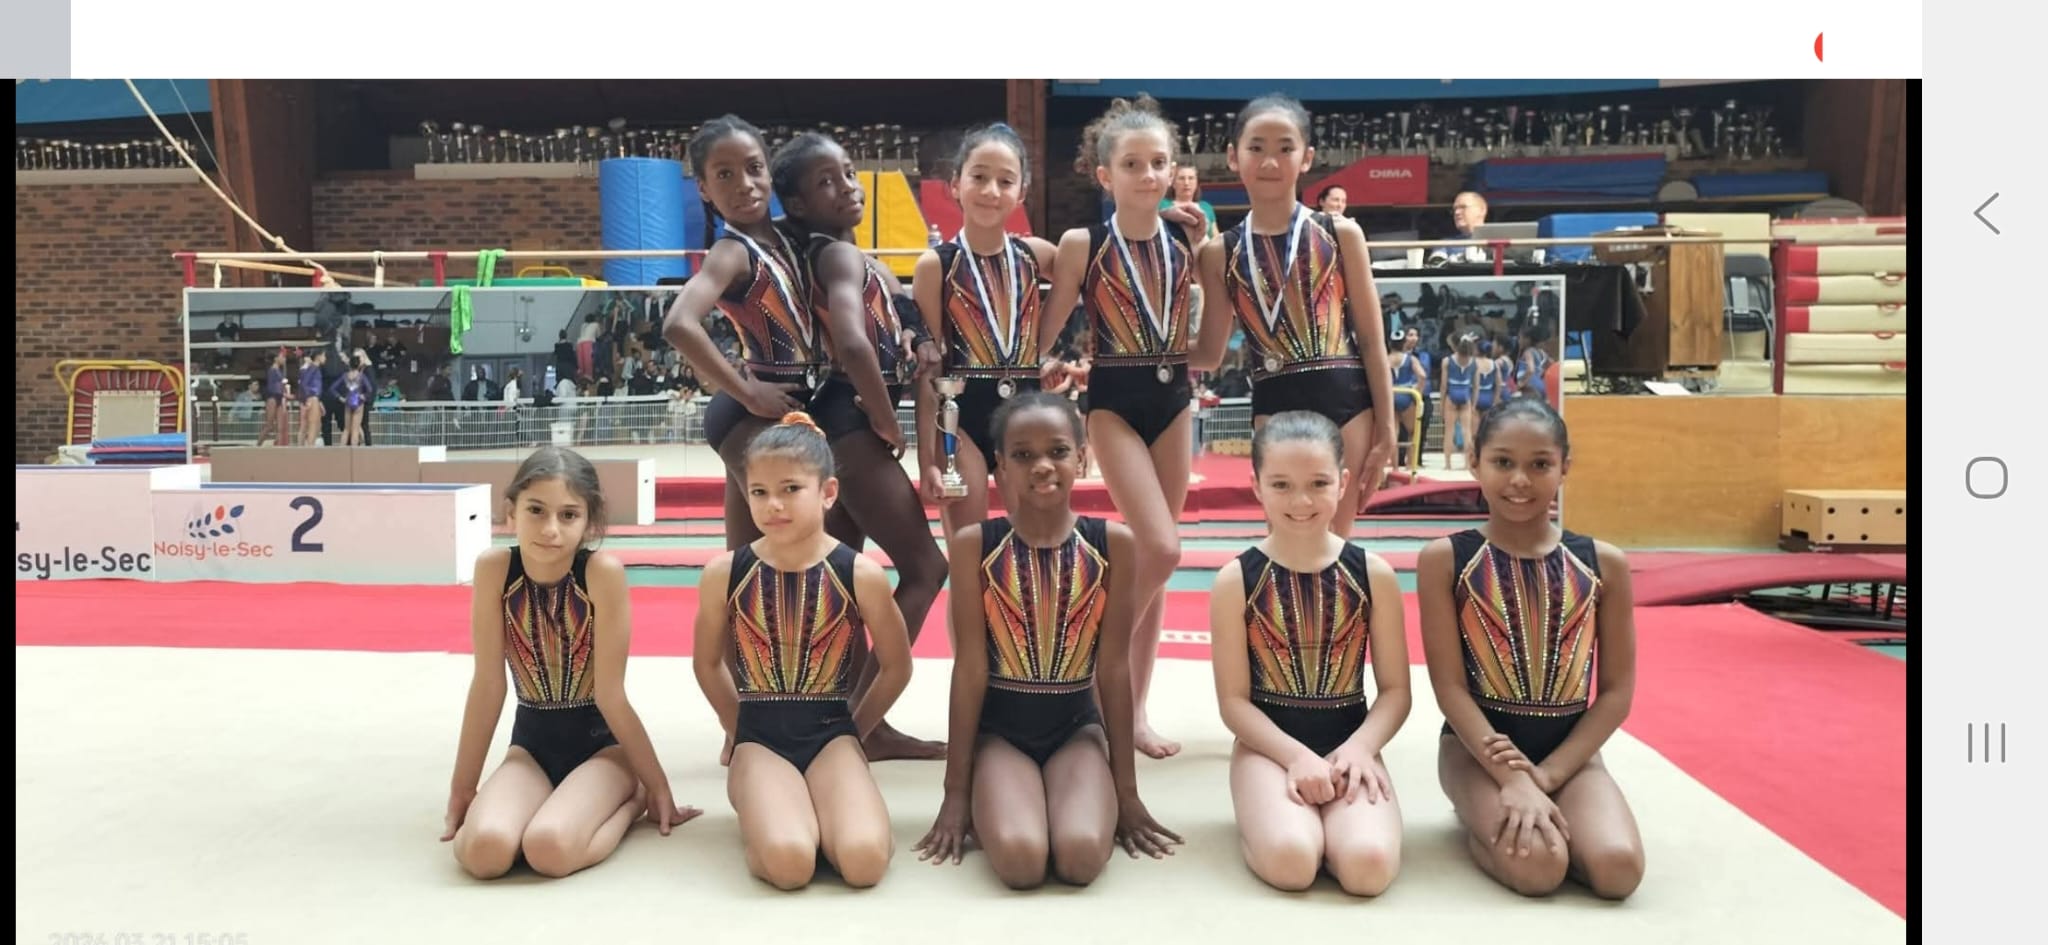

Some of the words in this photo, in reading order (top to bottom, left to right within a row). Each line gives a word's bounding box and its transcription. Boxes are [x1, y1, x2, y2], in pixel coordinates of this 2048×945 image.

[1369, 169, 1413, 178] DIMA
[289, 496, 324, 552] 2
[154, 541, 273, 561] Noisy-le-Sec
